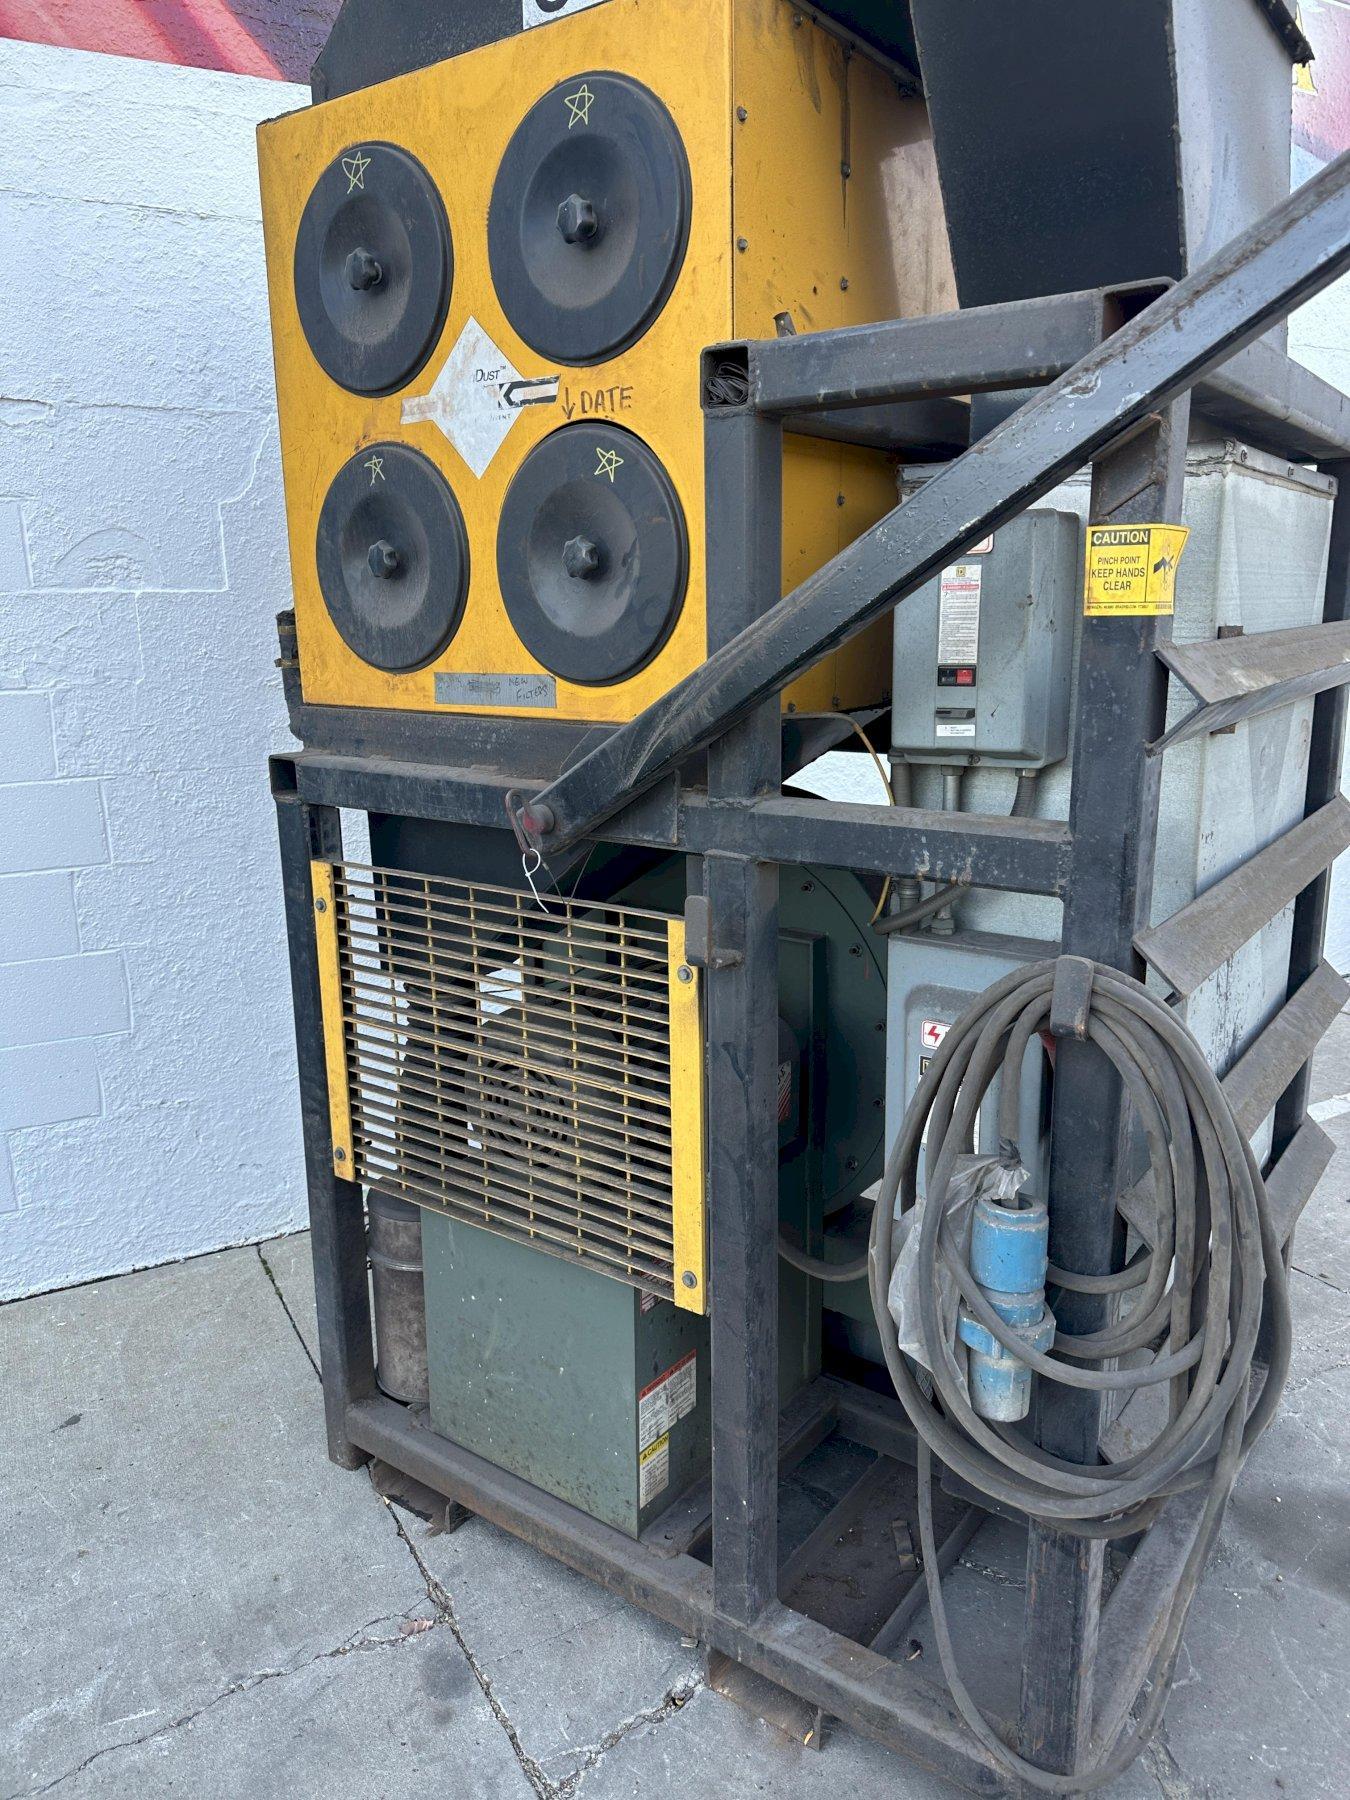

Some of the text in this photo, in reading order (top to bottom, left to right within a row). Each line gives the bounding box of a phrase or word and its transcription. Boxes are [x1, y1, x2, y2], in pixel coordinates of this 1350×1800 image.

[580, 385, 634, 414] DATE
[1093, 531, 1148, 544] CAUTION
[1097, 556, 1140, 565] PINCH POINT
[1091, 567, 1145, 578] KEEP HANDS
[1103, 580, 1132, 591] CLEAR
[508, 677, 528, 687] NEW
[516, 685, 548, 701] FILTERS
[647, 1435, 669, 1457] CAUTION
